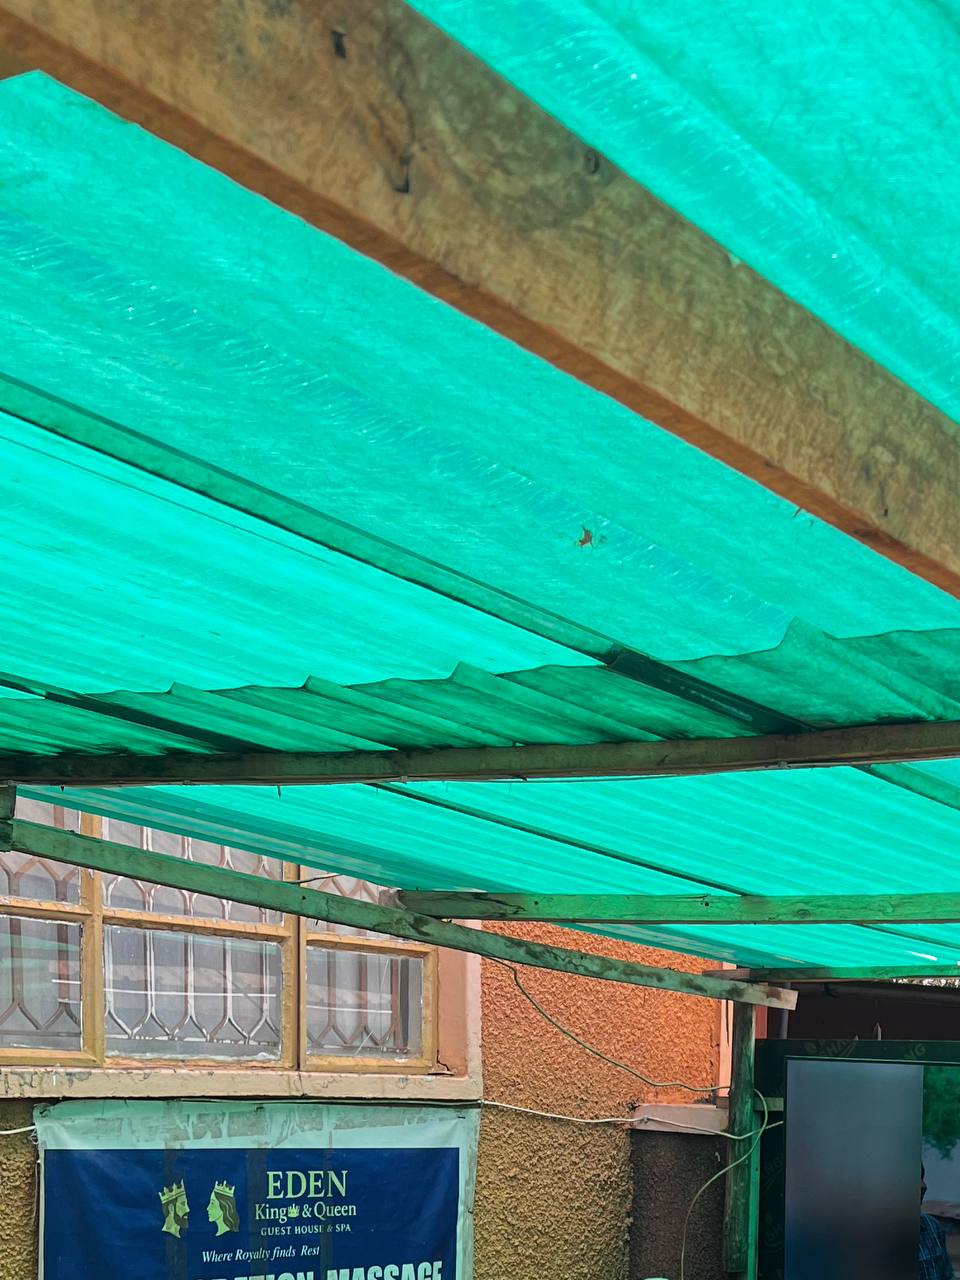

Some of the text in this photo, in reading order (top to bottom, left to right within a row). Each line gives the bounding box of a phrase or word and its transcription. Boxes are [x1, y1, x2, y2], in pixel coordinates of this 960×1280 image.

[266, 1170, 348, 1199] EDEN
[255, 1201, 357, 1224] King & Queen
[260, 1223, 352, 1236] GUEST HOUSE & SPA
[202, 1244, 321, 1264] Where Royalty finds Rest
